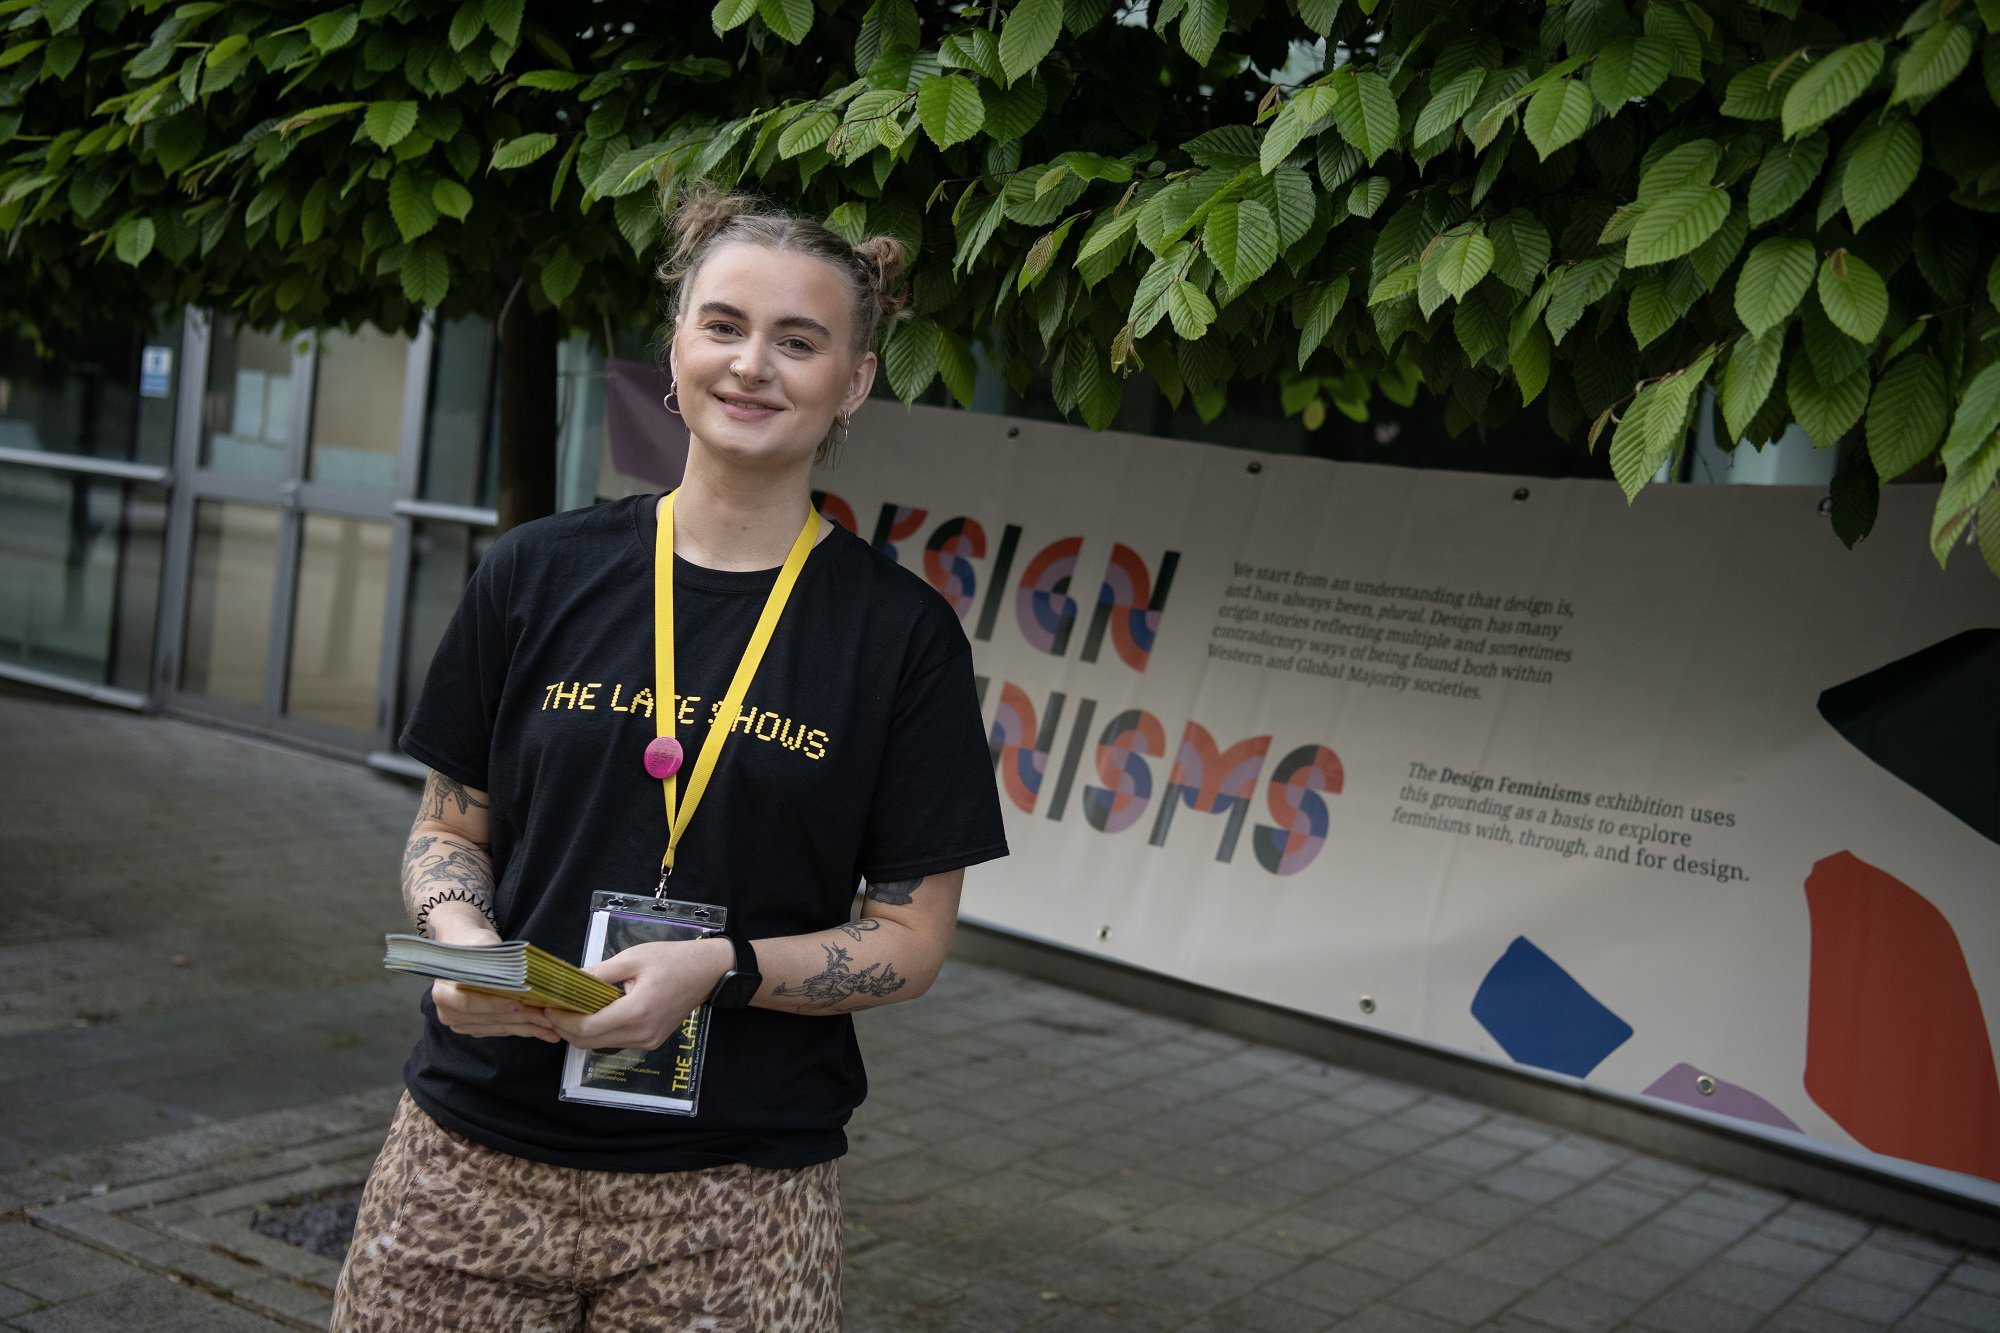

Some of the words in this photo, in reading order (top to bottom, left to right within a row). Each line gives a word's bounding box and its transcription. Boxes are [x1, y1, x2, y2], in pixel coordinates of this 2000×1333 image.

[1225, 585, 1250, 599] and
[1253, 586, 1278, 603] has
[1282, 592, 1332, 612] always
[1430, 609, 1483, 632] Design
[1487, 616, 1513, 634] has
[1516, 621, 1562, 641] many
[1234, 561, 1252, 578] We
[1256, 567, 1290, 584] start
[1293, 571, 1328, 589] from
[1331, 577, 1350, 592] an
[1354, 579, 1465, 609] understanding
[1469, 591, 1500, 611] that
[1504, 596, 1553, 617] design
[1556, 600, 1574, 618] is,
[1212, 625, 1305, 653] contradictory
[1310, 640, 1346, 659] ways
[1350, 643, 1367, 661] of
[1367, 647, 1410, 670] being
[1412, 653, 1459, 673] found
[1463, 659, 1498, 678] both
[1502, 664, 1552, 684] within
[1219, 605, 1259, 623] origin
[1262, 610, 1309, 630] stories
[1312, 618, 1383, 644] reflecting
[1386, 628, 1450, 650] multiple
[1453, 638, 1486, 655] and
[1489, 644, 1571, 663] sometimes
[1208, 642, 1263, 666] Western
[1266, 656, 1293, 671] and
[1296, 658, 1343, 679] Global
[1347, 666, 1410, 692] Majority
[1413, 678, 1480, 699] societies.
[541, 681, 602, 711] THE
[611, 684, 701, 724] LAE
[1400, 784, 1429, 803] this
[1429, 790, 1511, 821] grounding
[1515, 806, 1534, 821] as
[1536, 811, 1547, 824] a
[1552, 809, 1595, 832] basis
[1598, 816, 1614, 835] to
[1618, 820, 1692, 847] explore
[1407, 762, 1437, 782] The
[1439, 767, 1493, 793] Design
[1499, 777, 1591, 806] Feminisms
[1595, 792, 1684, 820] exhibition
[1691, 808, 1736, 828] uses
[1392, 805, 1471, 836] feminisms
[1475, 822, 1514, 845] with,
[1518, 829, 1588, 858] through,
[1594, 844, 1630, 865] and
[1635, 848, 1667, 870] for
[1673, 854, 1750, 882] design.
[672, 1055, 693, 1092] THE
